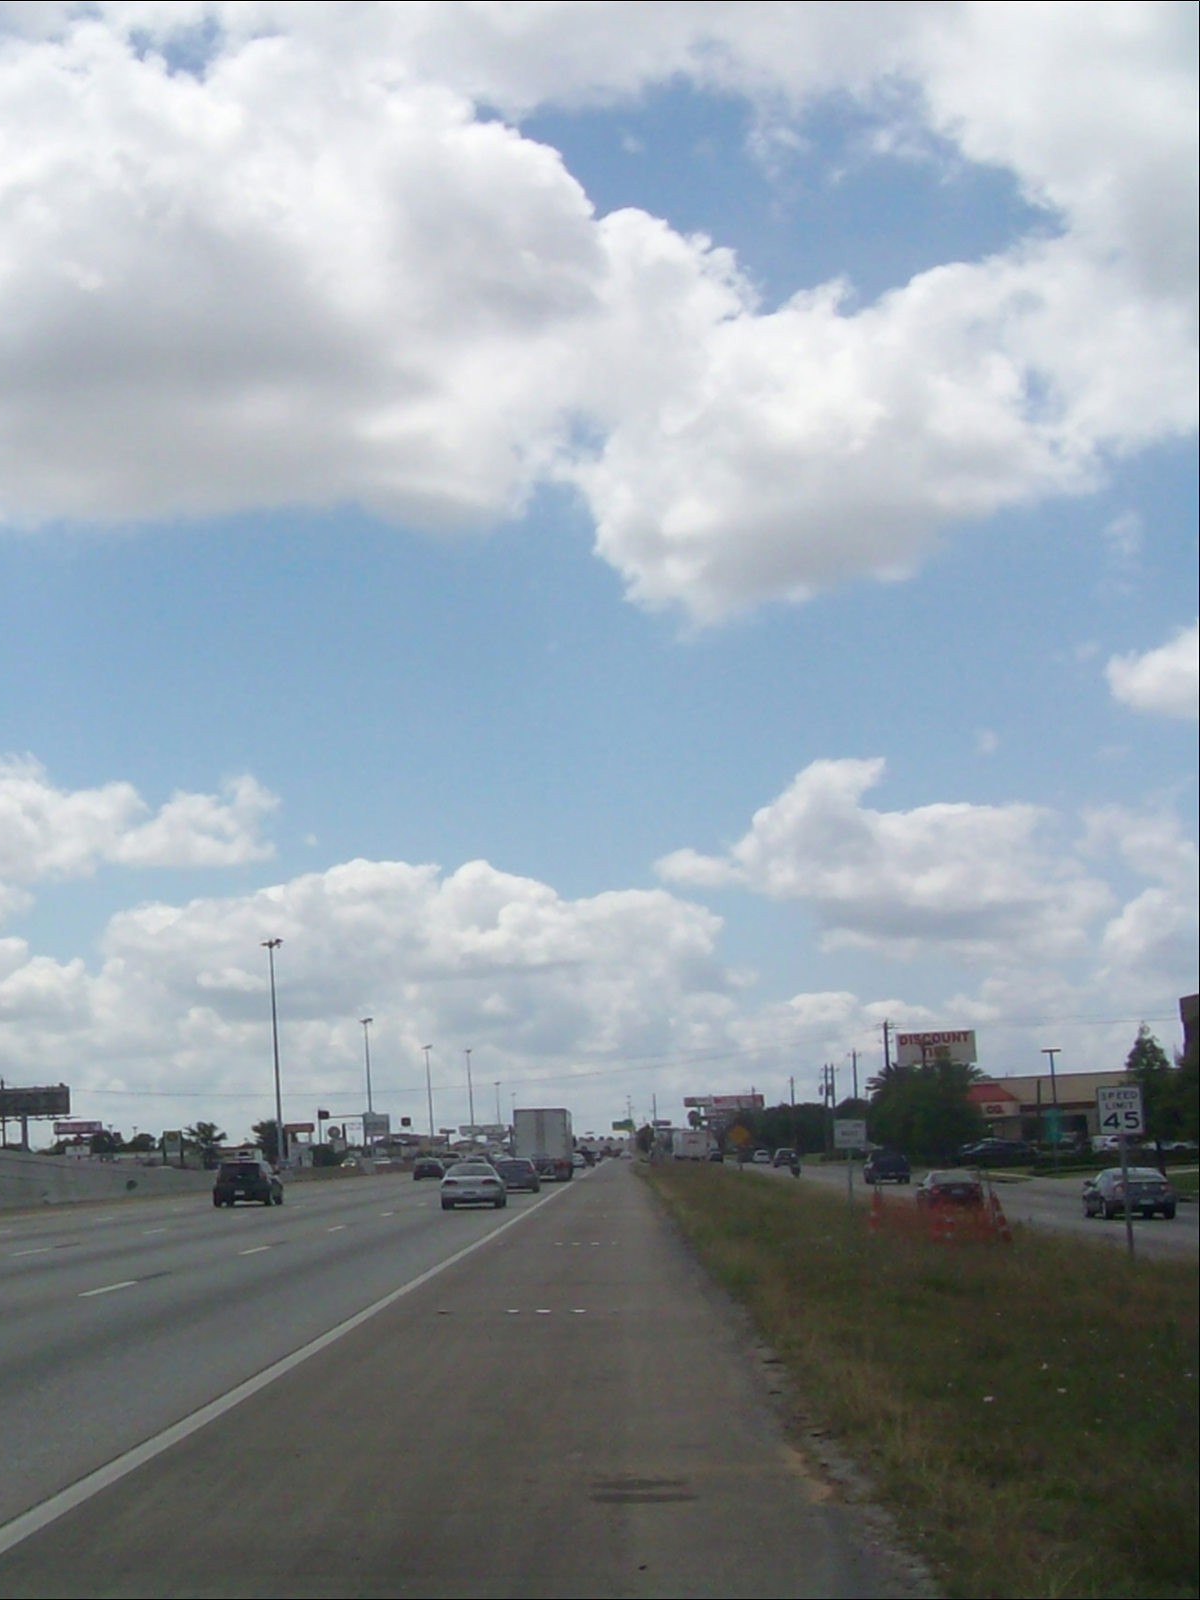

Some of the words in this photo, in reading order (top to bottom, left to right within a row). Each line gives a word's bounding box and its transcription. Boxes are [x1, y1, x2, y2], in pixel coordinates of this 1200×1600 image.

[900, 1030, 970, 1046] DISCOUNT
[1101, 1091, 1138, 1100] SPEED
[1105, 1101, 1133, 1110] LIMIT
[1103, 1111, 1140, 1129] 45
